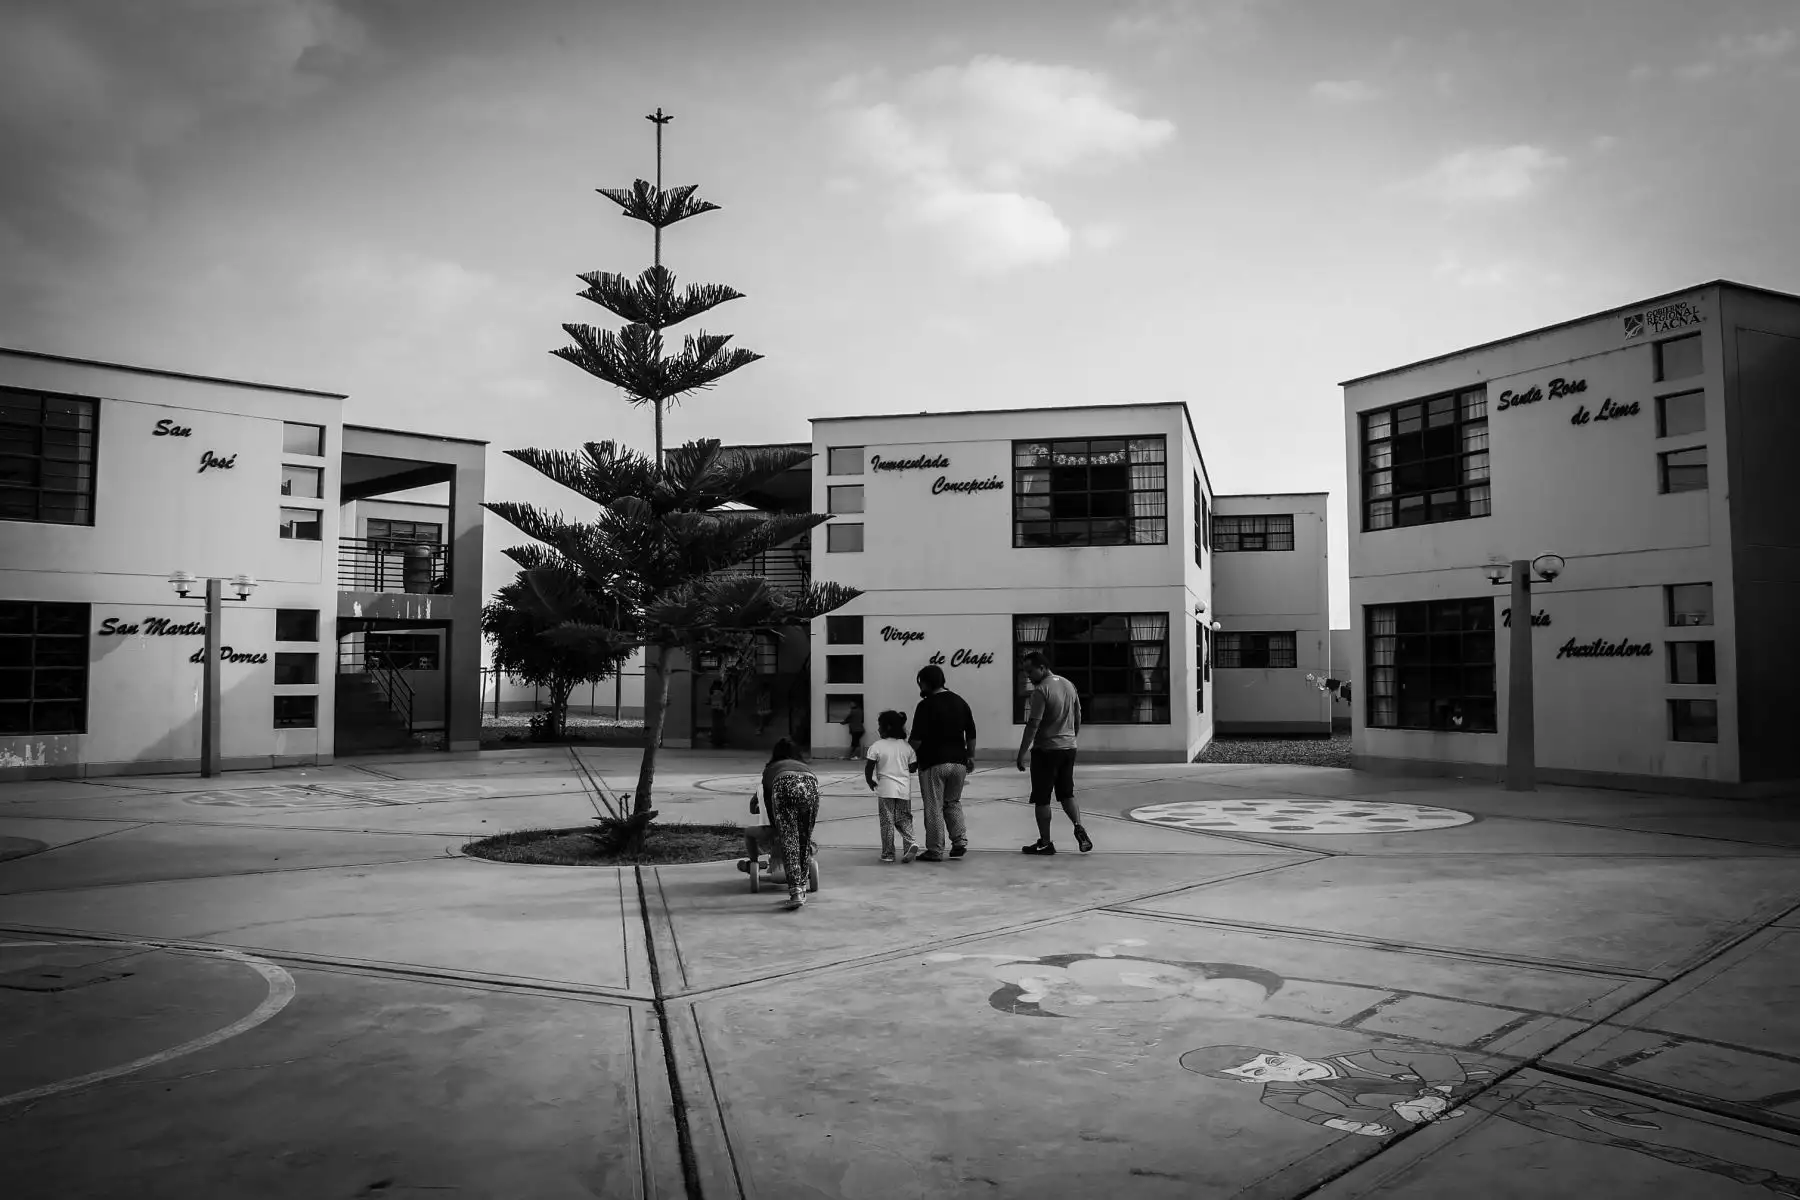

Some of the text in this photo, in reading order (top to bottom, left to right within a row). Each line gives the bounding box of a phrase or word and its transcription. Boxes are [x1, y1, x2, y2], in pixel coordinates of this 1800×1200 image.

[1647, 306, 1700, 326] REGIONAL
[1653, 314, 1701, 333] TACNA
[1497, 378, 1587, 411] Santa Rosa
[1571, 398, 1640, 425] de Lima
[152, 419, 192, 437] San
[197, 451, 237, 474] José
[871, 455, 950, 472] Inmaculada
[932, 475, 1004, 495] Concepción
[98, 618, 139, 635] San
[881, 626, 925, 646] Virgen
[929, 648, 994, 668] de Chapi
[1556, 637, 1653, 659] Auxiliadora
